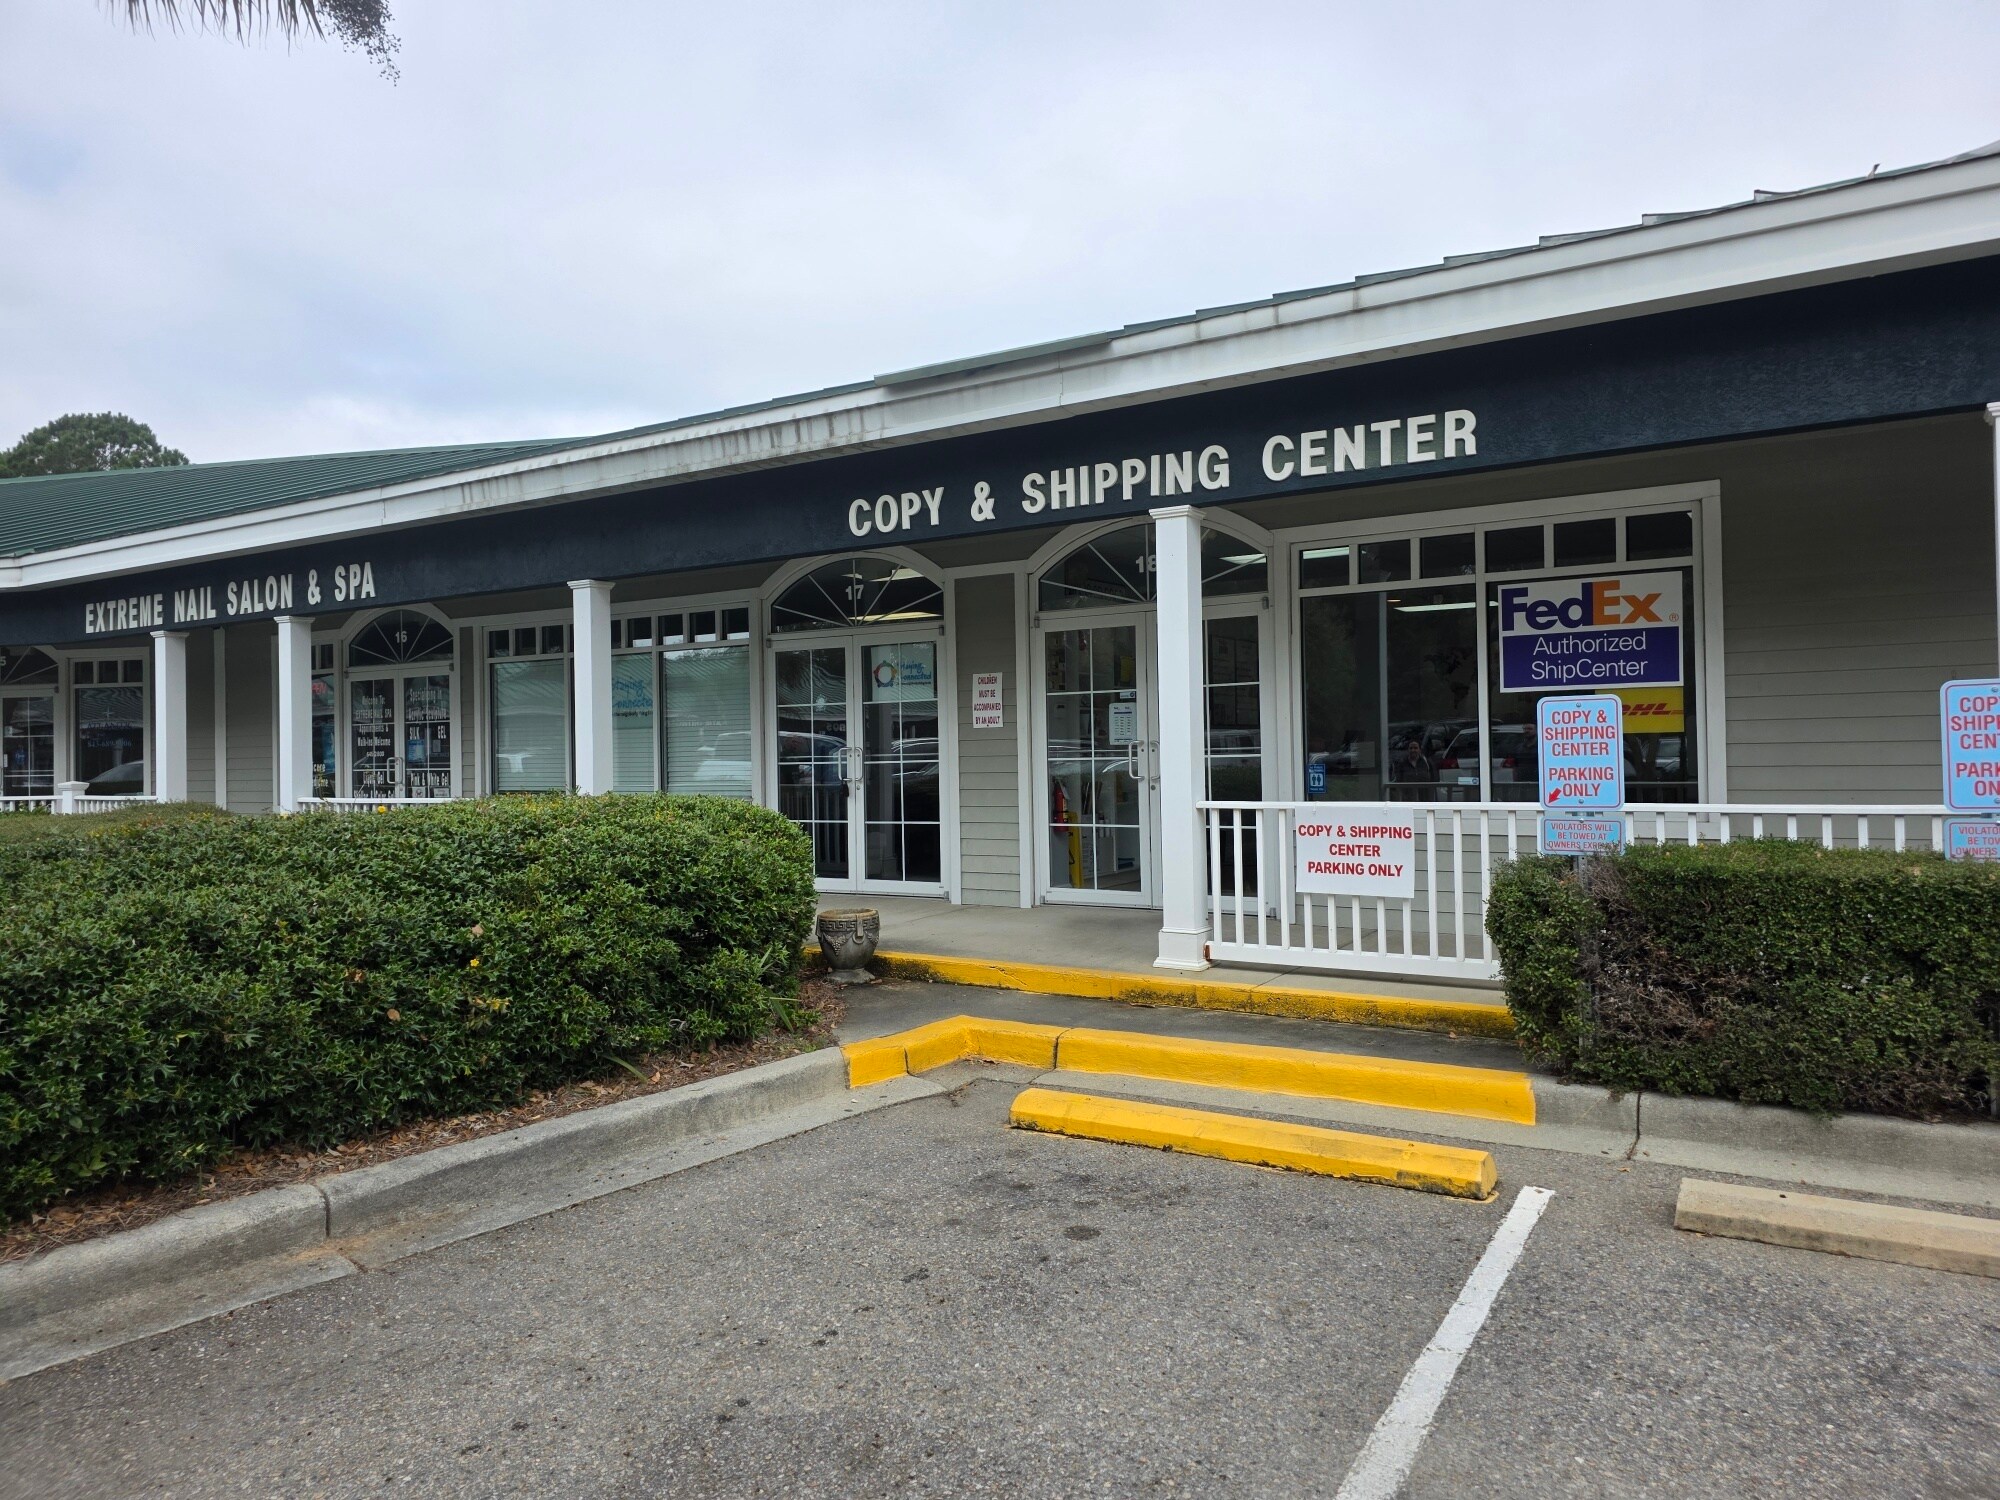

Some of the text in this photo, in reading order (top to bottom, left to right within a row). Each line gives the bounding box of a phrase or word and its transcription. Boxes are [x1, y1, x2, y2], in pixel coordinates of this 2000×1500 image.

[848, 409, 1477, 537] COPY & SHIPPING CENTER
[85, 561, 376, 634] EXTREME NAIL SALON & SPA
[845, 584, 864, 601] 17
[1501, 580, 1663, 632] FedEx
[395, 630, 408, 644] 16
[1533, 631, 1646, 656] Authorized
[1531, 659, 1648, 683] ShipCenter
[978, 676, 997, 685] CHILDREN
[978, 689, 996, 698] MUST BE
[974, 702, 1001, 711] ACCOMPANIED
[1960, 696, 2000, 713] COP
[975, 716, 1000, 725] BY AN ADULT
[1552, 709, 1607, 725] COPY &
[409, 725, 447, 740] SILK GEL
[1545, 725, 1616, 741] SHIPPING
[1960, 733, 2000, 750] CEN
[1552, 742, 1609, 756] CENTER
[1549, 767, 1614, 782] PARKING
[1563, 783, 1601, 797] ONLY
[1298, 825, 1412, 839] COPY & SHIPPING
[1551, 823, 1613, 832] VIOLATORS WILL
[1958, 826, 2000, 835] VIOLATO
[1557, 832, 1607, 841] BE TOWED AT
[1967, 837, 1978, 845] BE
[1329, 844, 1381, 857] CENTER
[1548, 841, 1580, 849] OWNERS
[1955, 847, 1997, 856] OWNERS
[1308, 861, 1403, 877] PARKING ONLY
